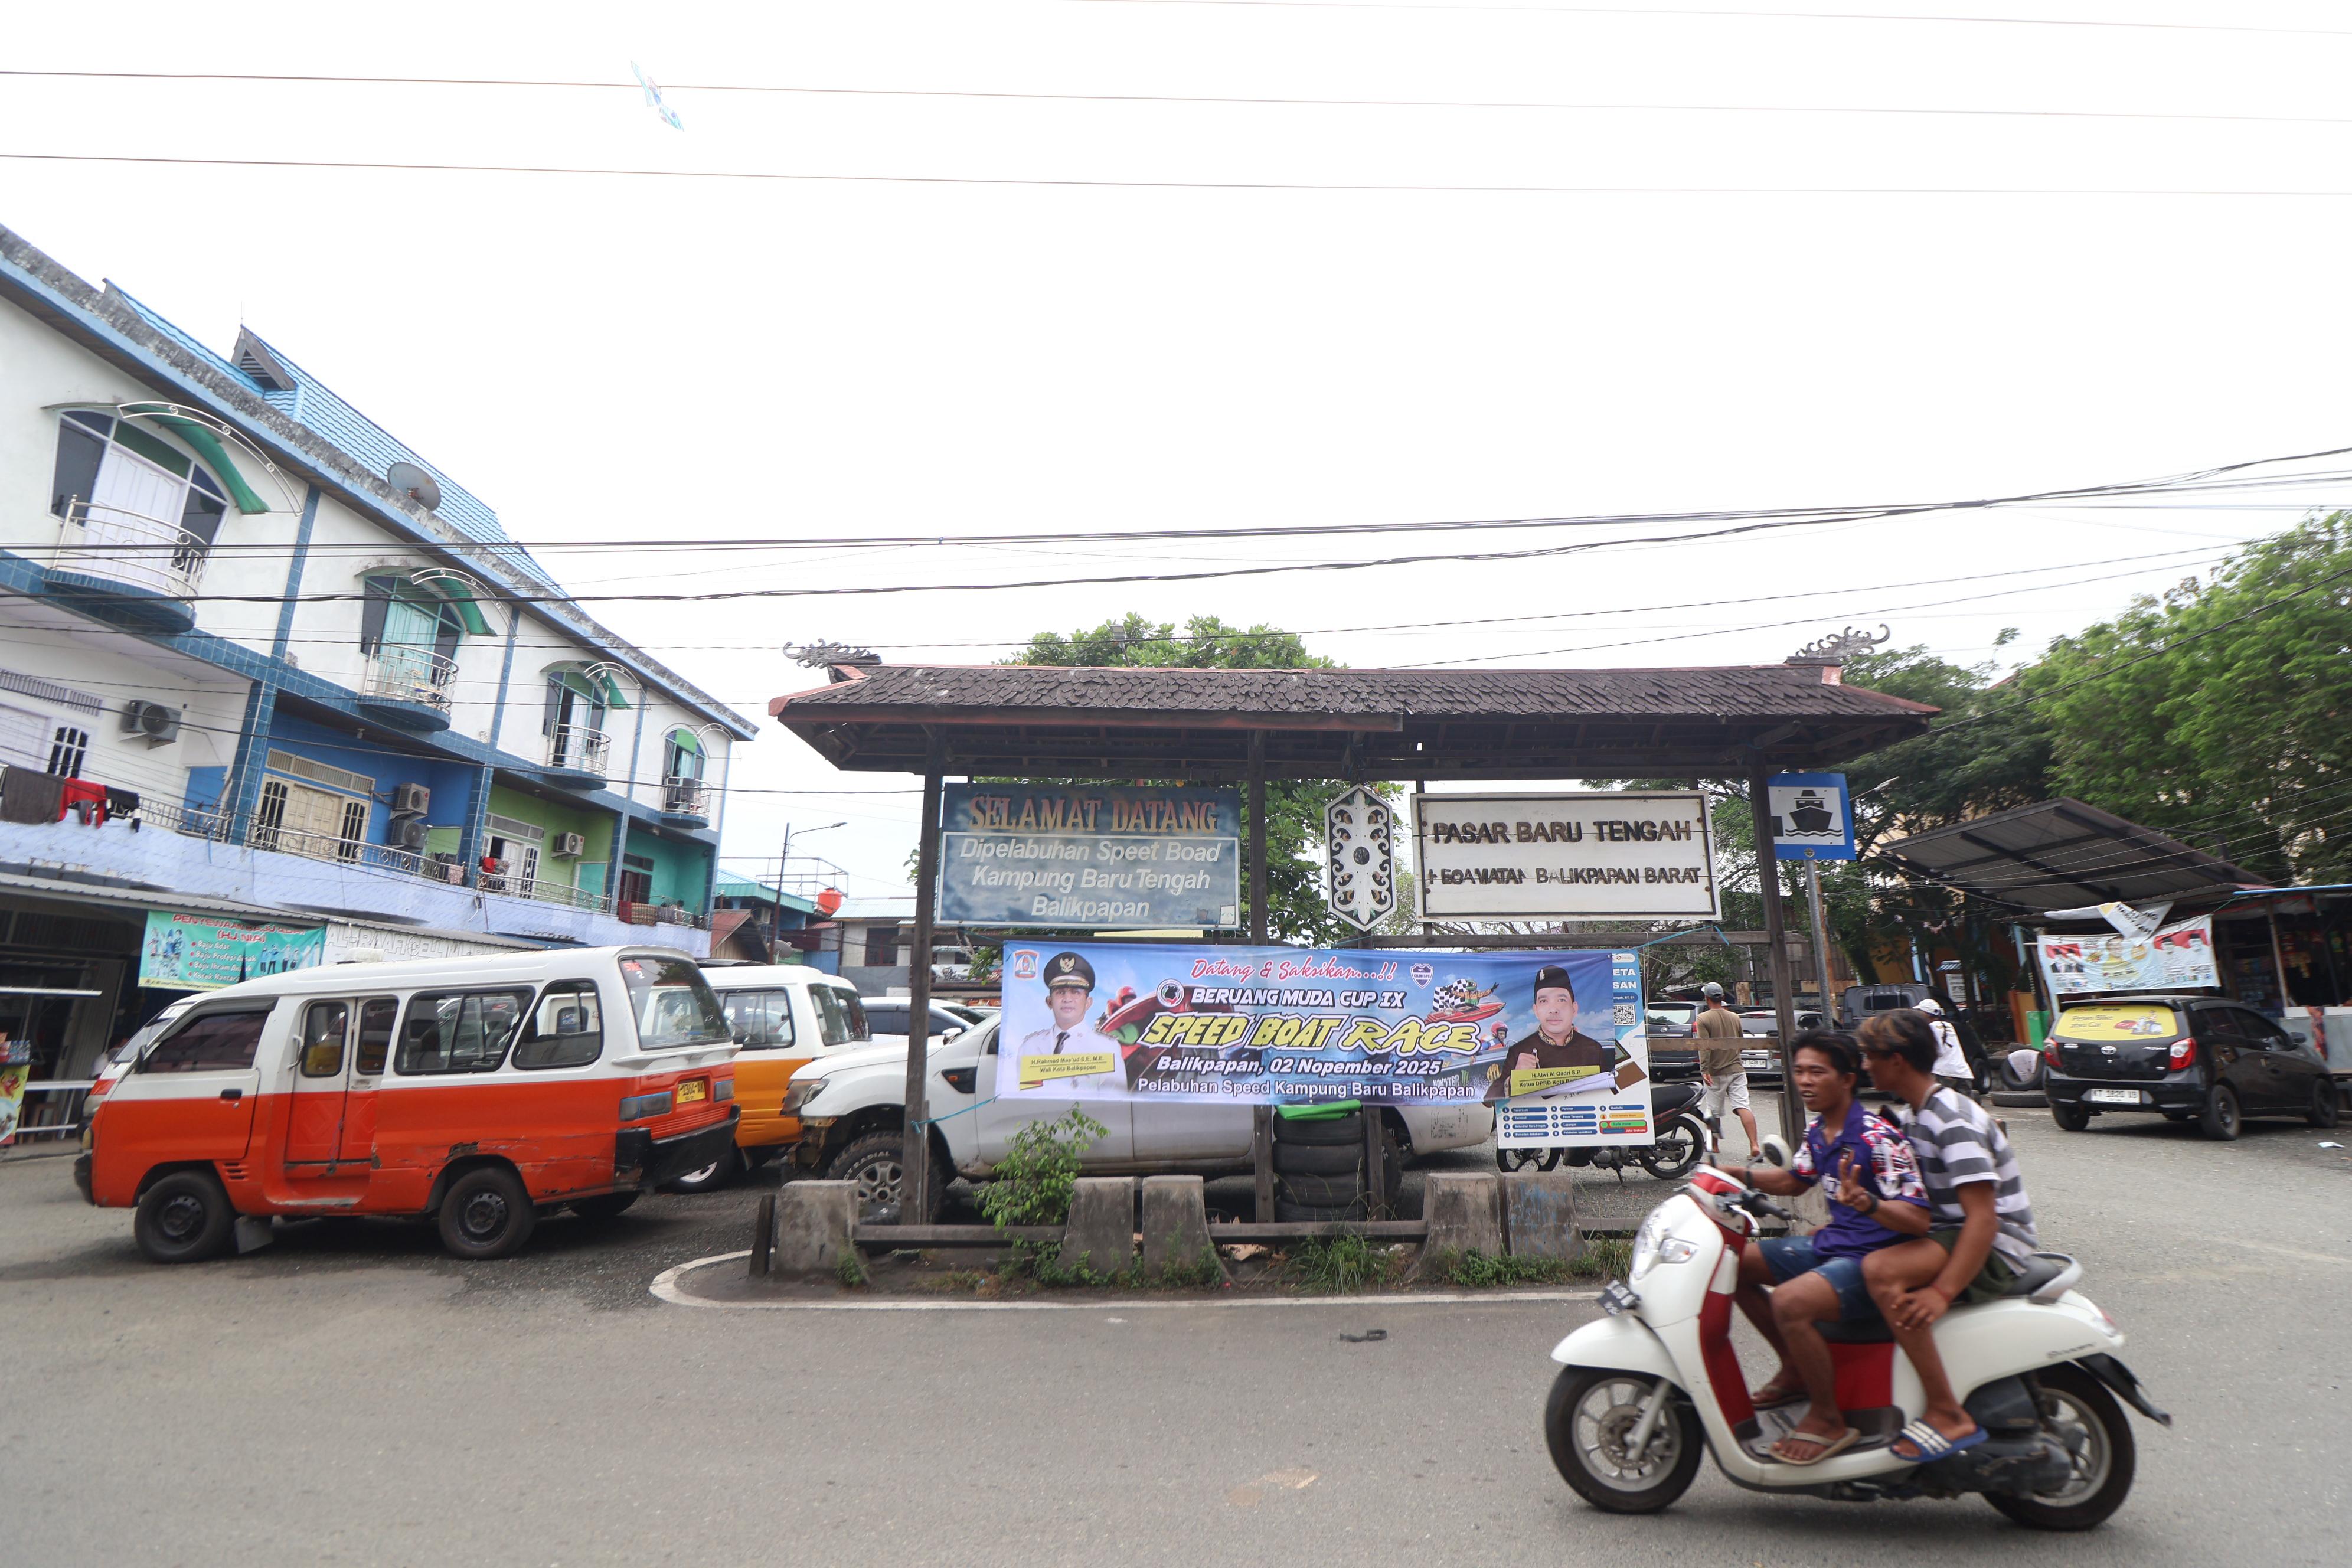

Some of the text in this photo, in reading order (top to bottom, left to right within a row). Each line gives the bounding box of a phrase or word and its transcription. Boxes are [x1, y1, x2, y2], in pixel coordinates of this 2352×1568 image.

[969, 796, 1218, 834] SELAMAT DATANG
[1433, 819, 1692, 844] PASAR BARU TENGAH
[959, 838, 1221, 865] Dipelabuhan Speet Boad
[971, 865, 1211, 896] Kampung Baru Tengah
[1535, 867, 1641, 884] BALIKPAPAN
[1644, 867, 1701, 884] BARAT
[1031, 896, 1150, 922] Balikpapan
[1191, 958, 1255, 984] Datang
[1259, 960, 1273, 979] &
[1191, 988, 1280, 1007] BERUANG
[1282, 990, 1335, 1007] MUDA
[1340, 991, 1377, 1007] CUP
[1380, 991, 1407, 1008] IX
[1142, 1014, 1481, 1056] SPEED BOAT RACE
[1157, 1056, 1443, 1078] Balikpapan, 02 Nopember 2025
[1138, 1078, 1475, 1099] Pelabuhan Speed Kampung Baru Balikpapan
[852, 1151, 891, 1168] RADIAL
